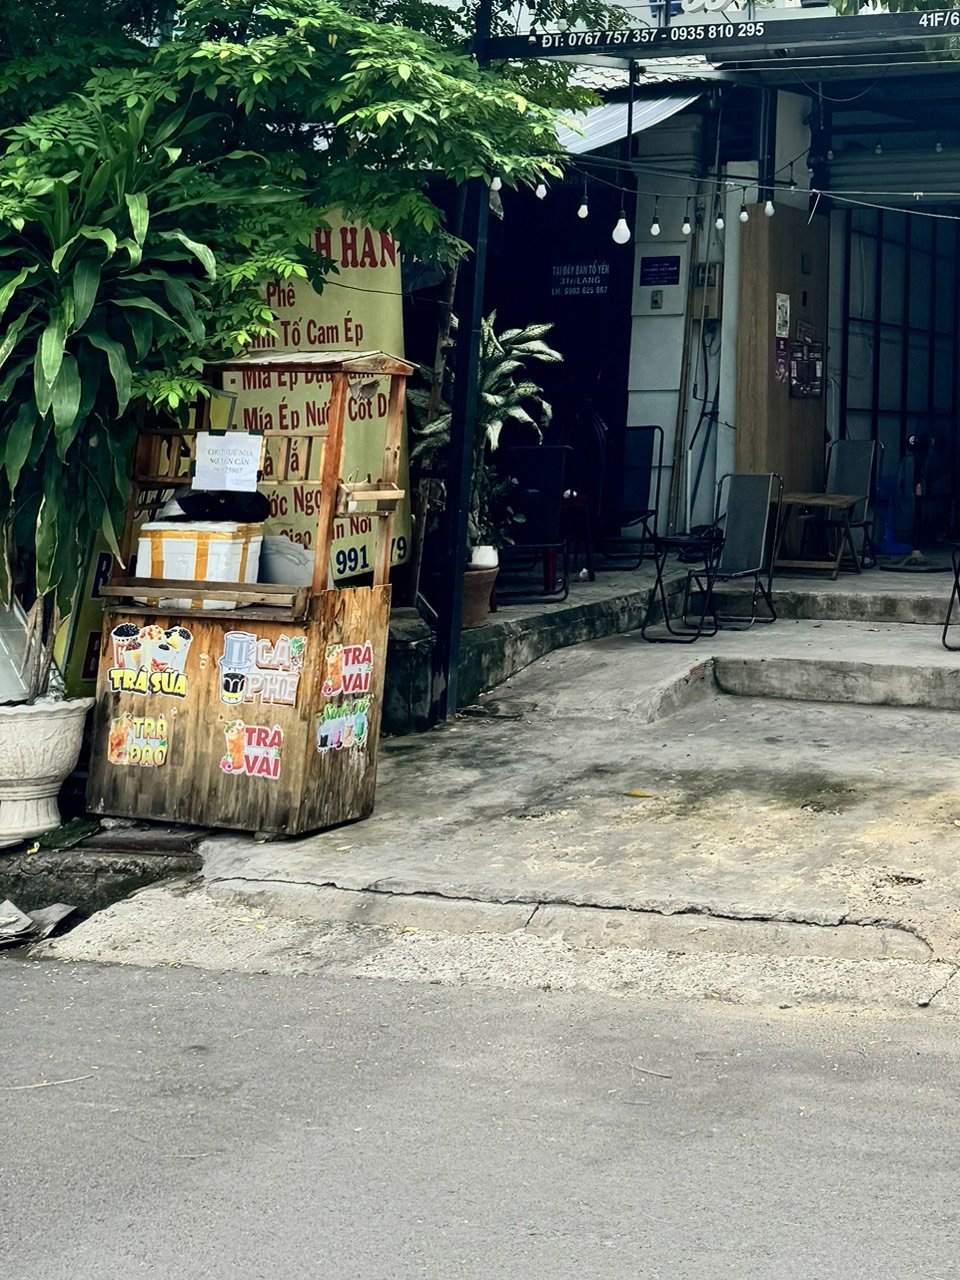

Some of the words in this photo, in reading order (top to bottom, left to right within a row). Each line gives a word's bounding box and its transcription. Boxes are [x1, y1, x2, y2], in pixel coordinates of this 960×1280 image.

[541, 34, 564, 48] ĐT:
[568, 30, 602, 46] 0767
[605, 29, 630, 44] 757
[632, 27, 658, 43] 357
[670, 25, 705, 41] 0935
[708, 23, 734, 39] 810
[738, 21, 765, 37] 295
[281, 316, 303, 347] Tố
[306, 319, 339, 346] Cam
[344, 310, 363, 347] Ép
[243, 406, 273, 430] Mía
[279, 396, 300, 430] Ép
[335, 544, 369, 575] 991
